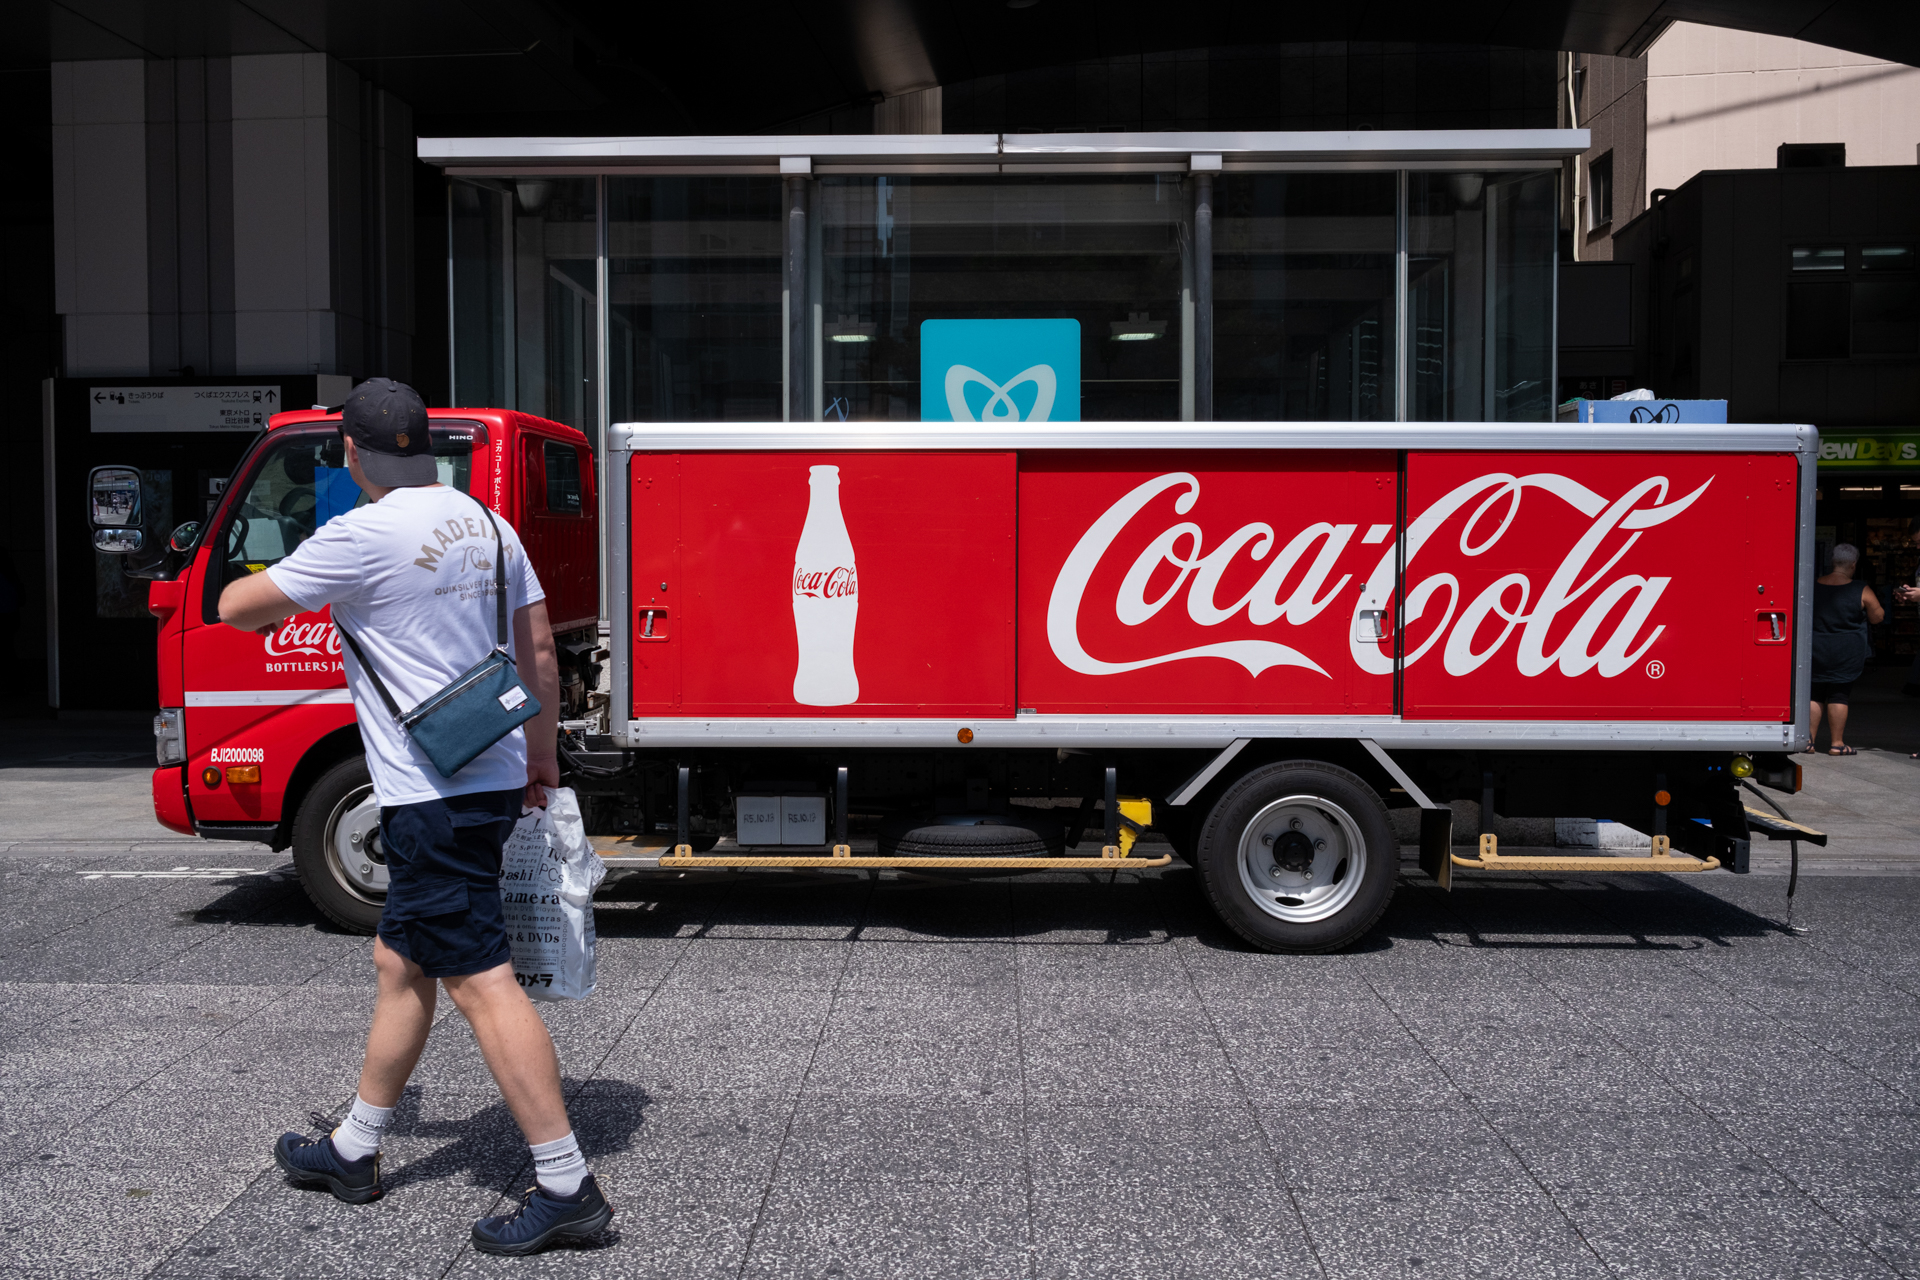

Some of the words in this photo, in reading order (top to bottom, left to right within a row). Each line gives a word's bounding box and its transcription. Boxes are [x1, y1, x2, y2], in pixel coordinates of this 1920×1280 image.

[128, 391, 165, 399] きっぷうりば
[193, 391, 250, 400] つくばエクスプレス
[1046, 472, 1716, 679] Coca-Cola
[793, 566, 858, 599] Coca-Cola
[265, 661, 329, 673] BOTTLERS
[210, 747, 264, 763] BJI2000098
[538, 862, 564, 884] PCs
[521, 914, 561, 922] Cameras
[516, 932, 525, 943] &
[528, 932, 560, 944] DVDs
